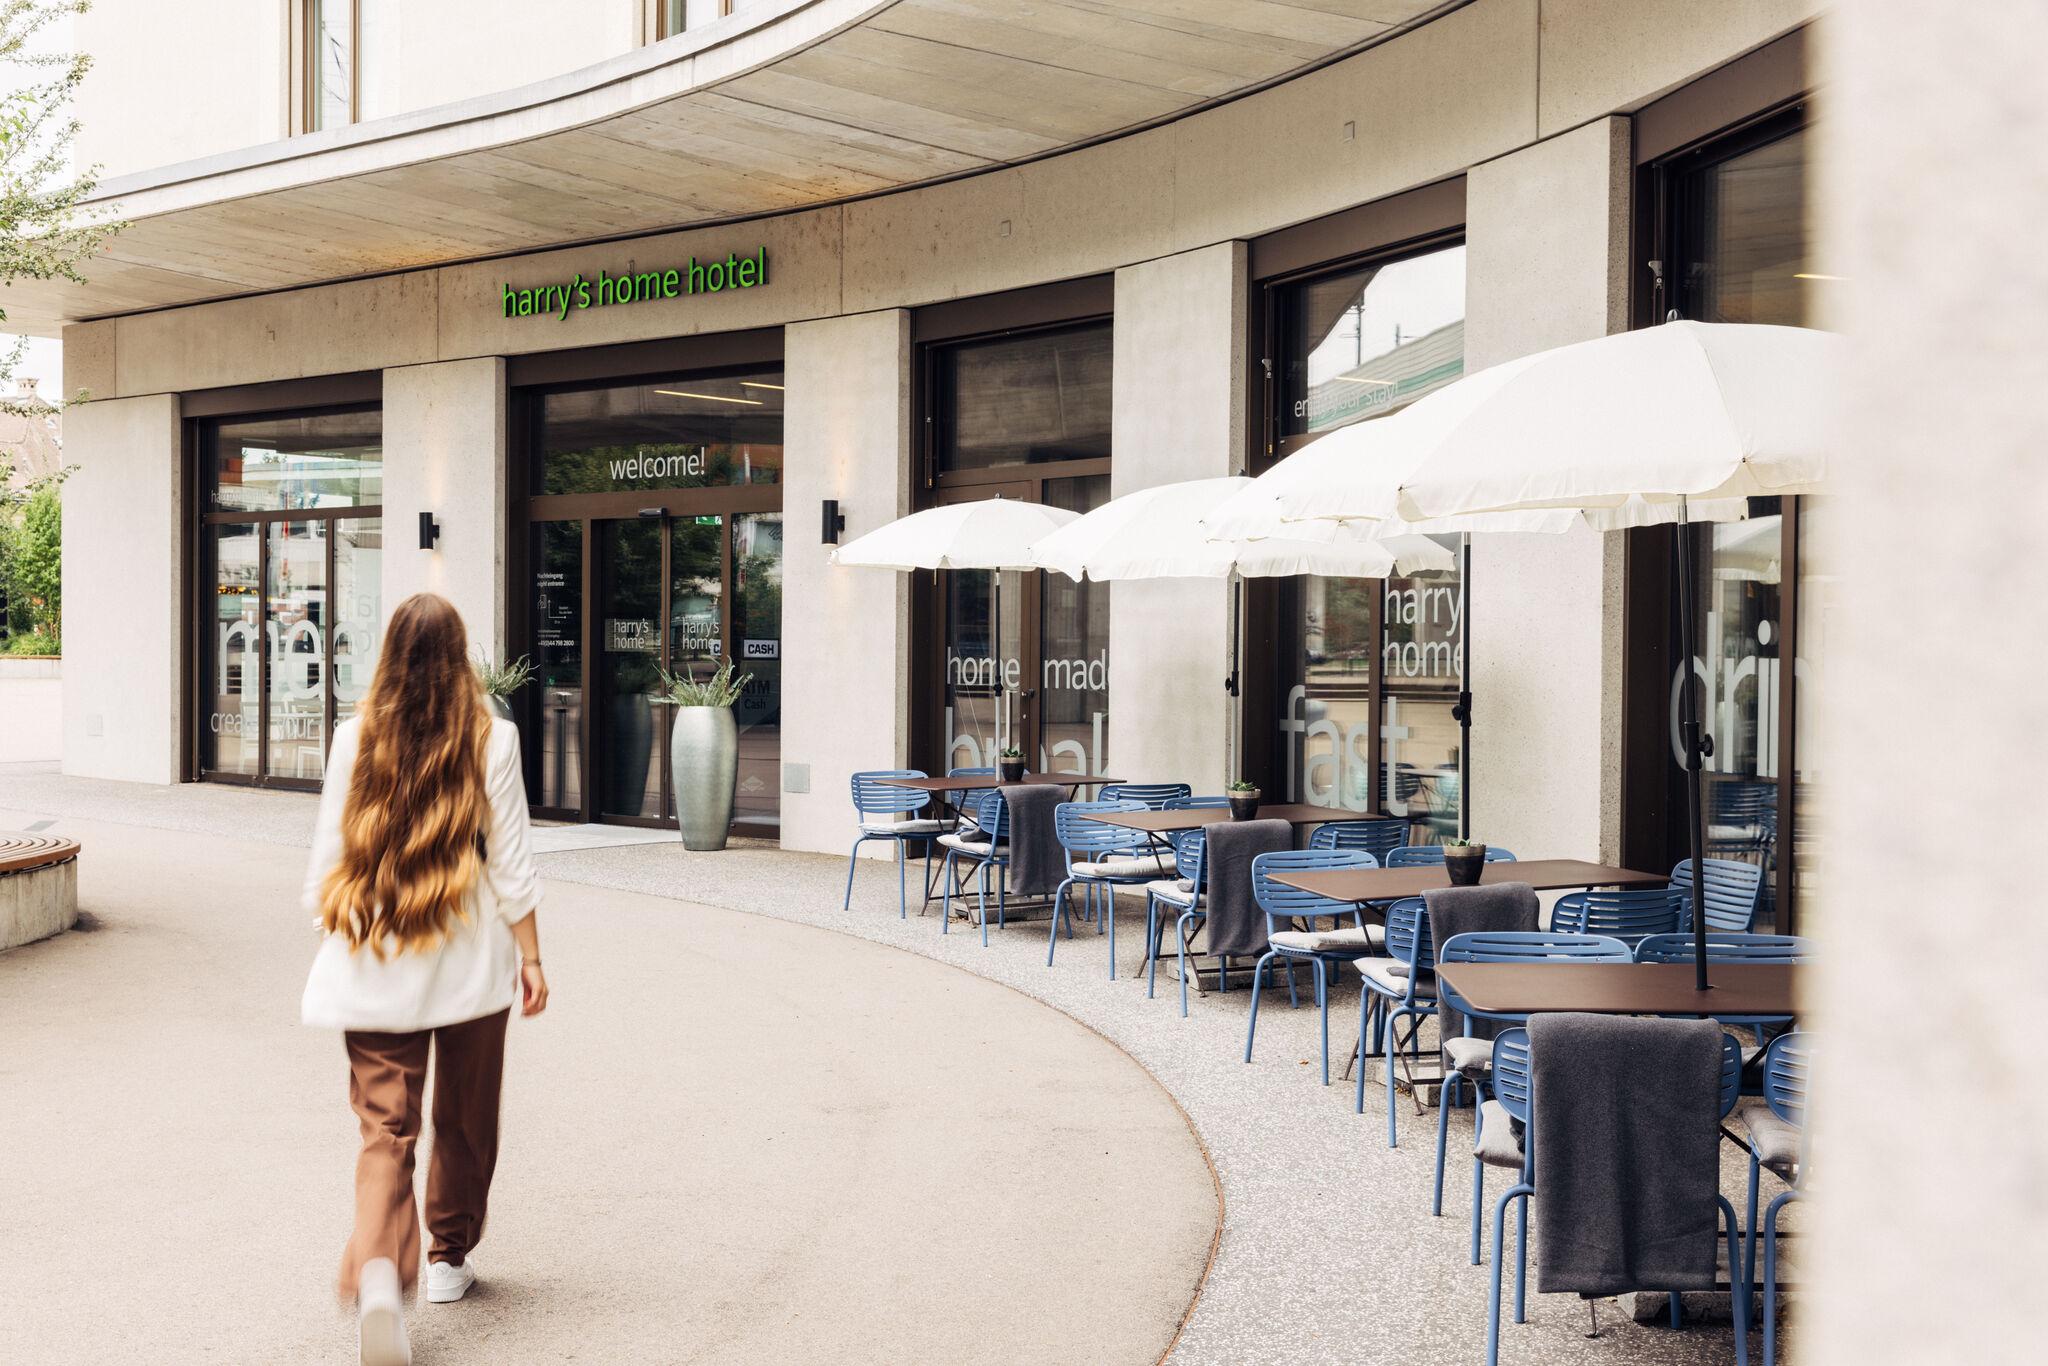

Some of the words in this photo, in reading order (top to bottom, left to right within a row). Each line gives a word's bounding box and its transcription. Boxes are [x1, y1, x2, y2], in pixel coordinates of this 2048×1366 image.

[502, 273, 591, 321] harry's
[598, 270, 681, 306] home
[688, 246, 766, 295] hotel
[610, 446, 706, 481] welcome!
[613, 617, 650, 638] harry's
[682, 616, 720, 638] harry's
[613, 635, 645, 650] home
[748, 644, 774, 655] CASH
[946, 646, 1020, 688] home
[1043, 649, 1110, 690] mad
[744, 698, 766, 710] Cash
[1279, 684, 1409, 818] fast
